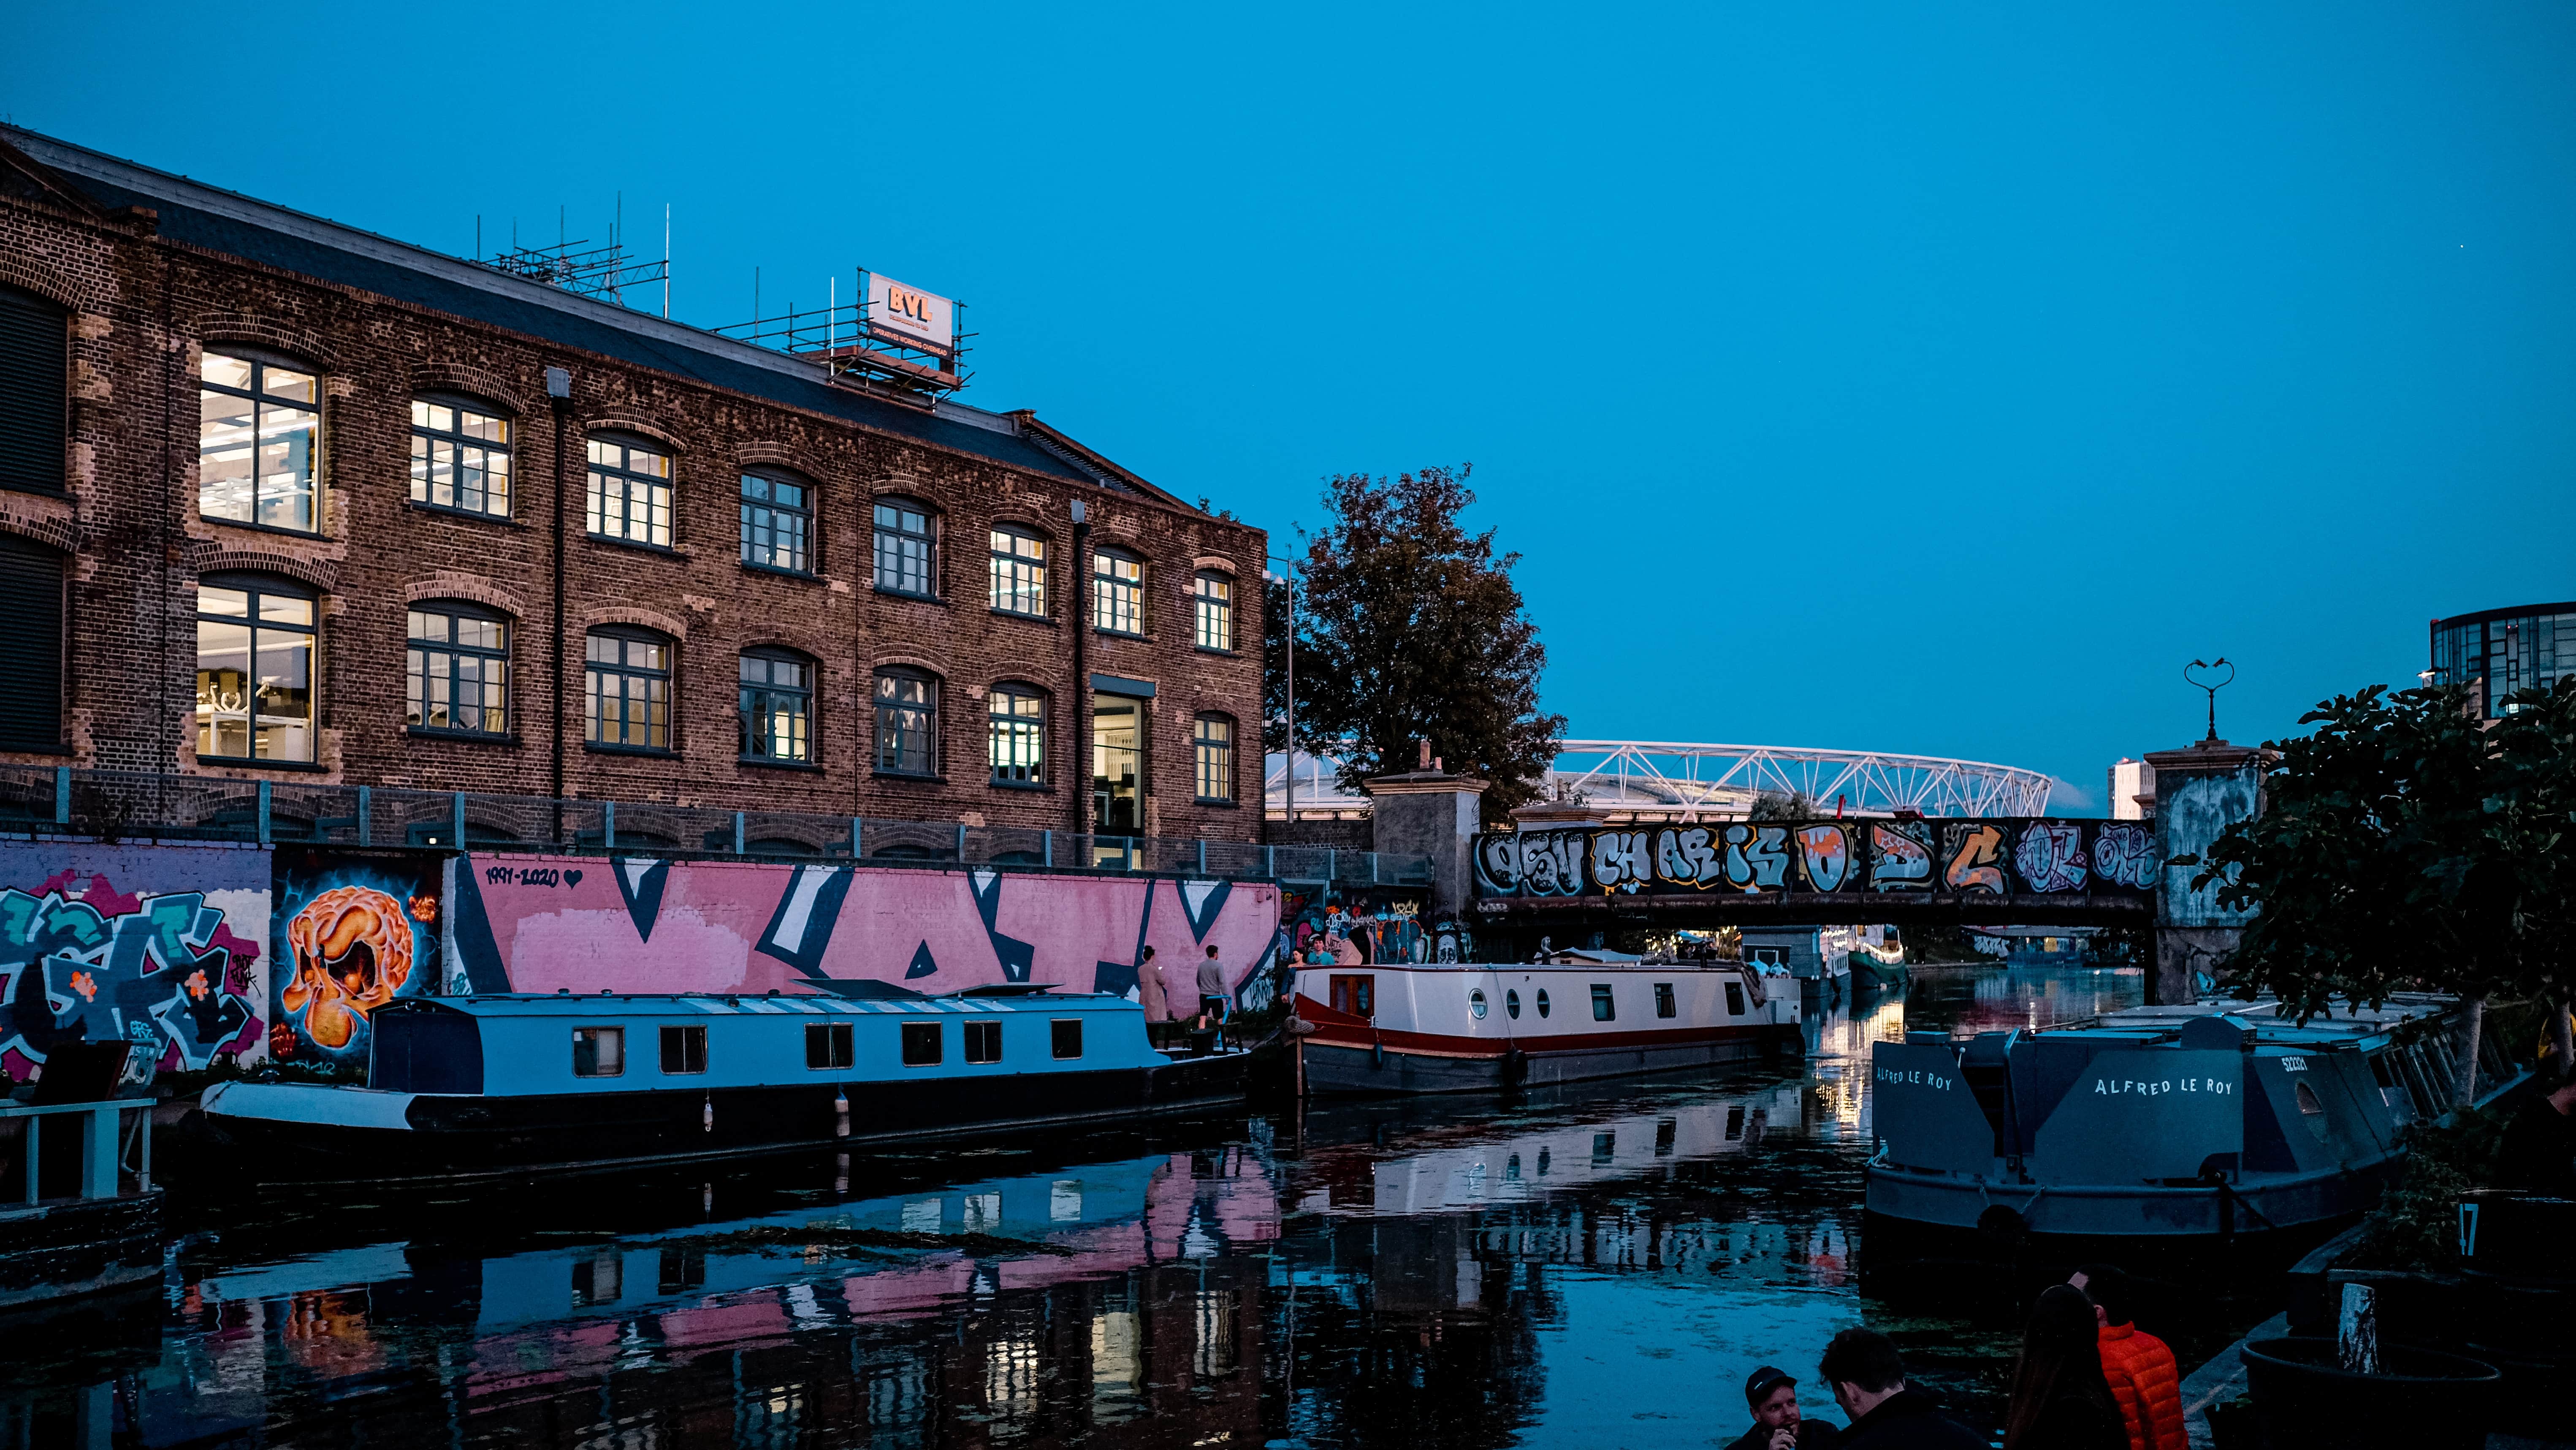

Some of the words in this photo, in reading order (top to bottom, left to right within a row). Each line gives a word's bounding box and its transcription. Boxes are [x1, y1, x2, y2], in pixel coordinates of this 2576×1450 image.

[889, 285, 932, 322] BVL
[873, 327, 899, 341] OPERATIVES
[900, 336, 922, 348] WORKING
[923, 343, 947, 356] OVERHEAD
[1876, 1067, 1903, 1084] ALFRED
[1909, 1071, 1920, 1084] LE
[1928, 1073, 1952, 1091] ROY
[2095, 1079, 2170, 1095] ALFRED
[2181, 1078, 2196, 1092] LE
[2207, 1078, 2232, 1095] ROY
[2459, 1203, 2479, 1256] 17
